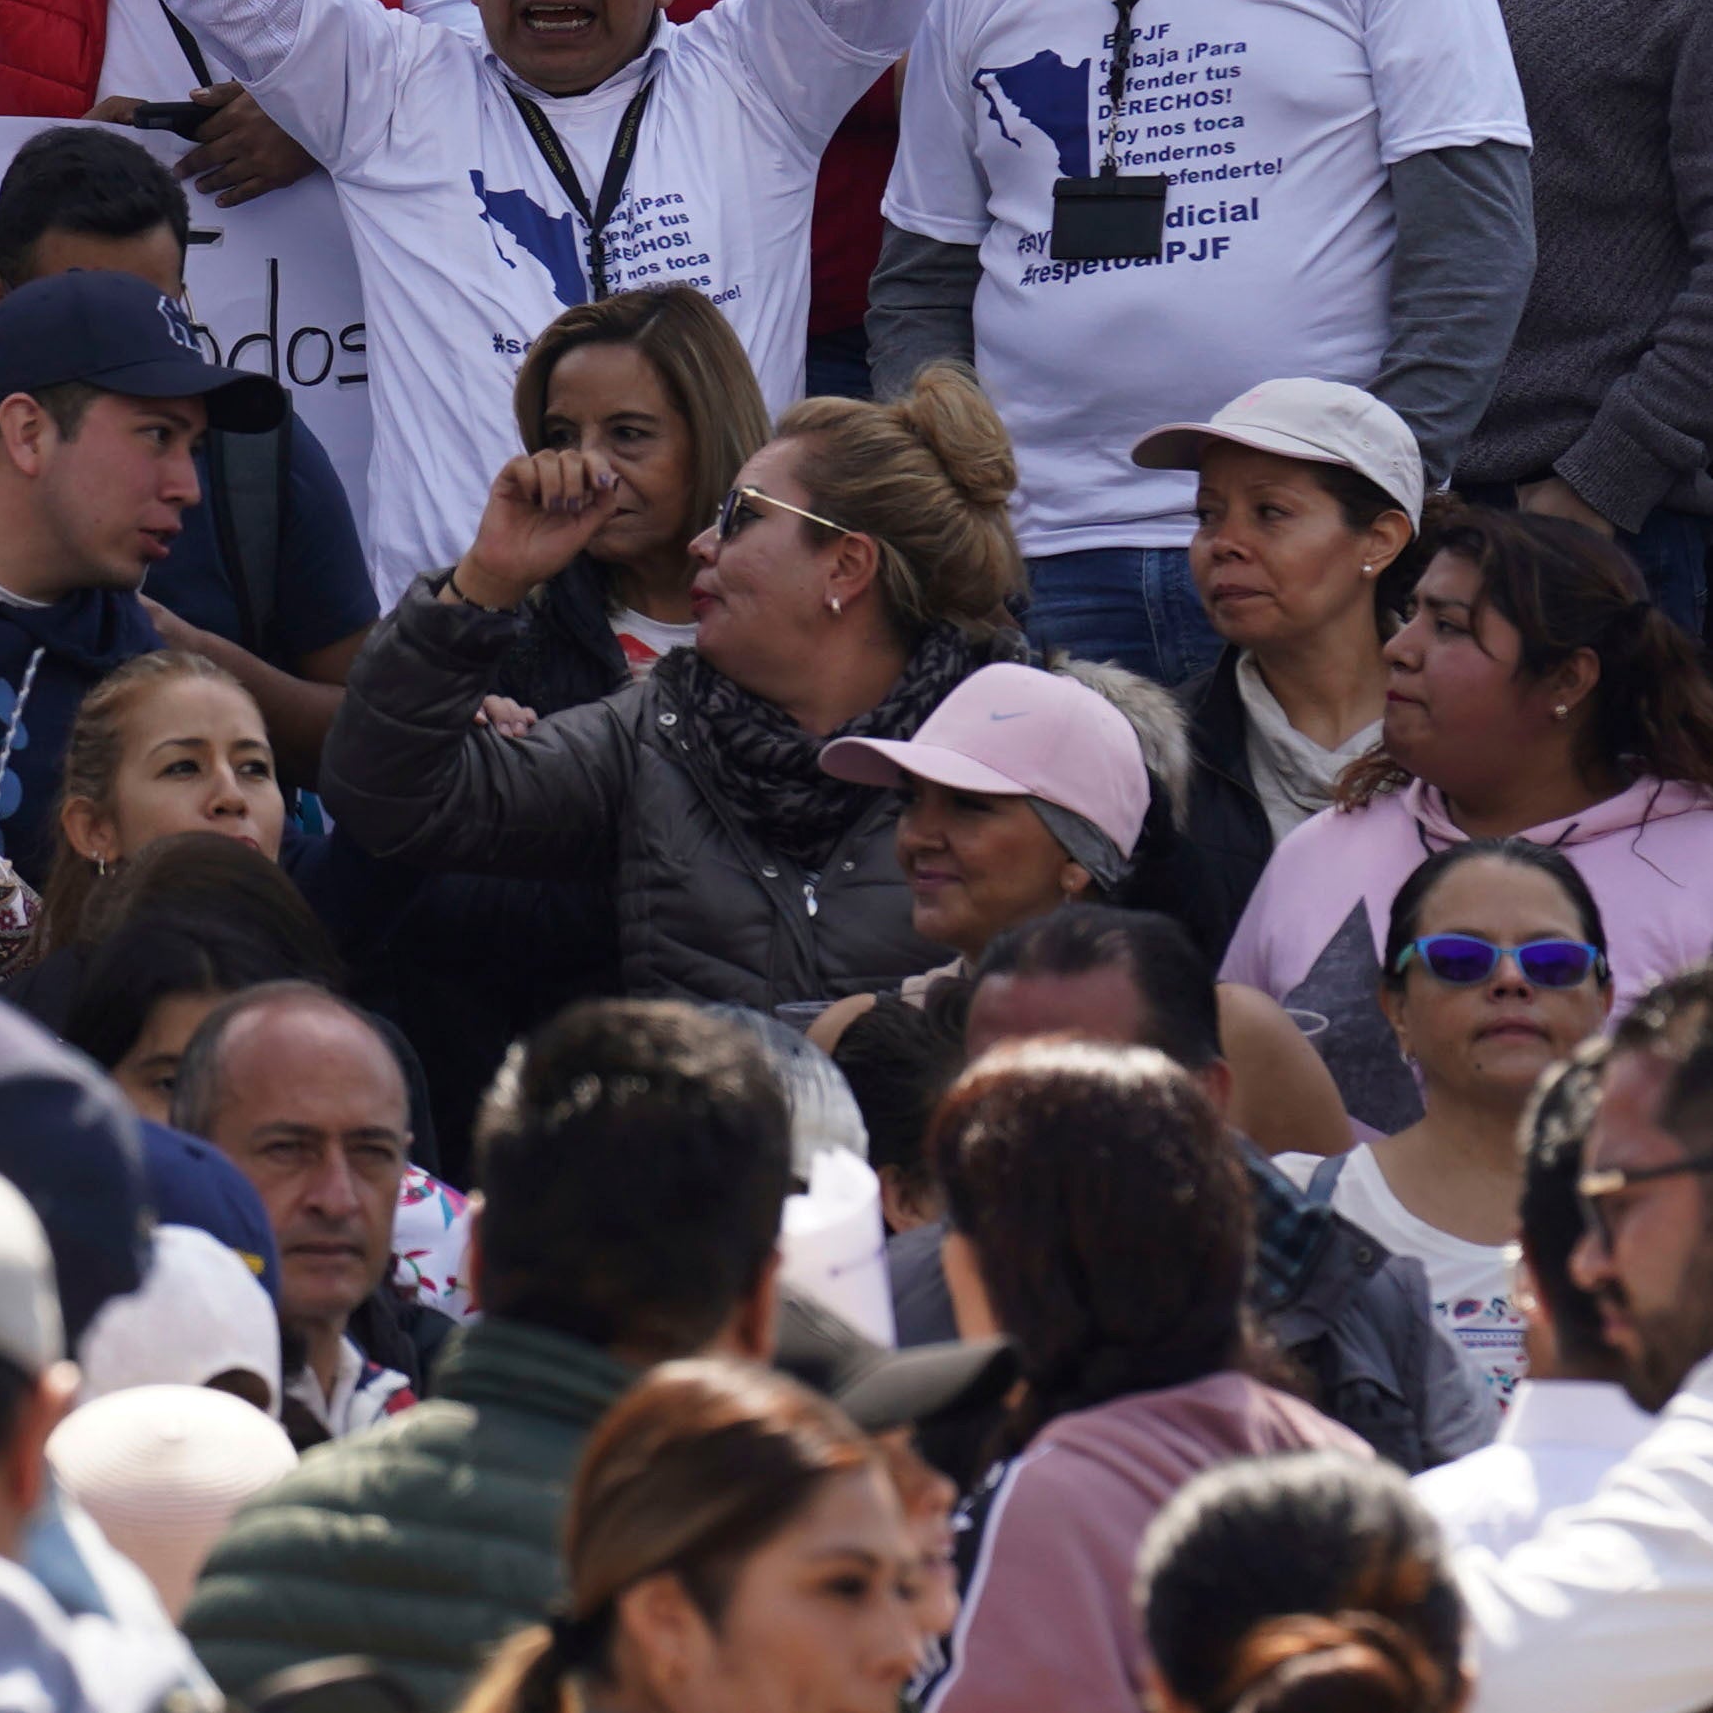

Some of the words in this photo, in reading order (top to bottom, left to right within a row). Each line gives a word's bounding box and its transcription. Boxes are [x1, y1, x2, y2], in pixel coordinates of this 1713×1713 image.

[1186, 39, 1247, 64] ¡Para
[1205, 64, 1242, 81] tus
[1147, 121, 1186, 139] nos
[1194, 113, 1246, 134] toca
[1161, 157, 1284, 188] efenderte!
[658, 212, 689, 227] tus
[627, 262, 660, 280] nos
[667, 252, 710, 270] toca
